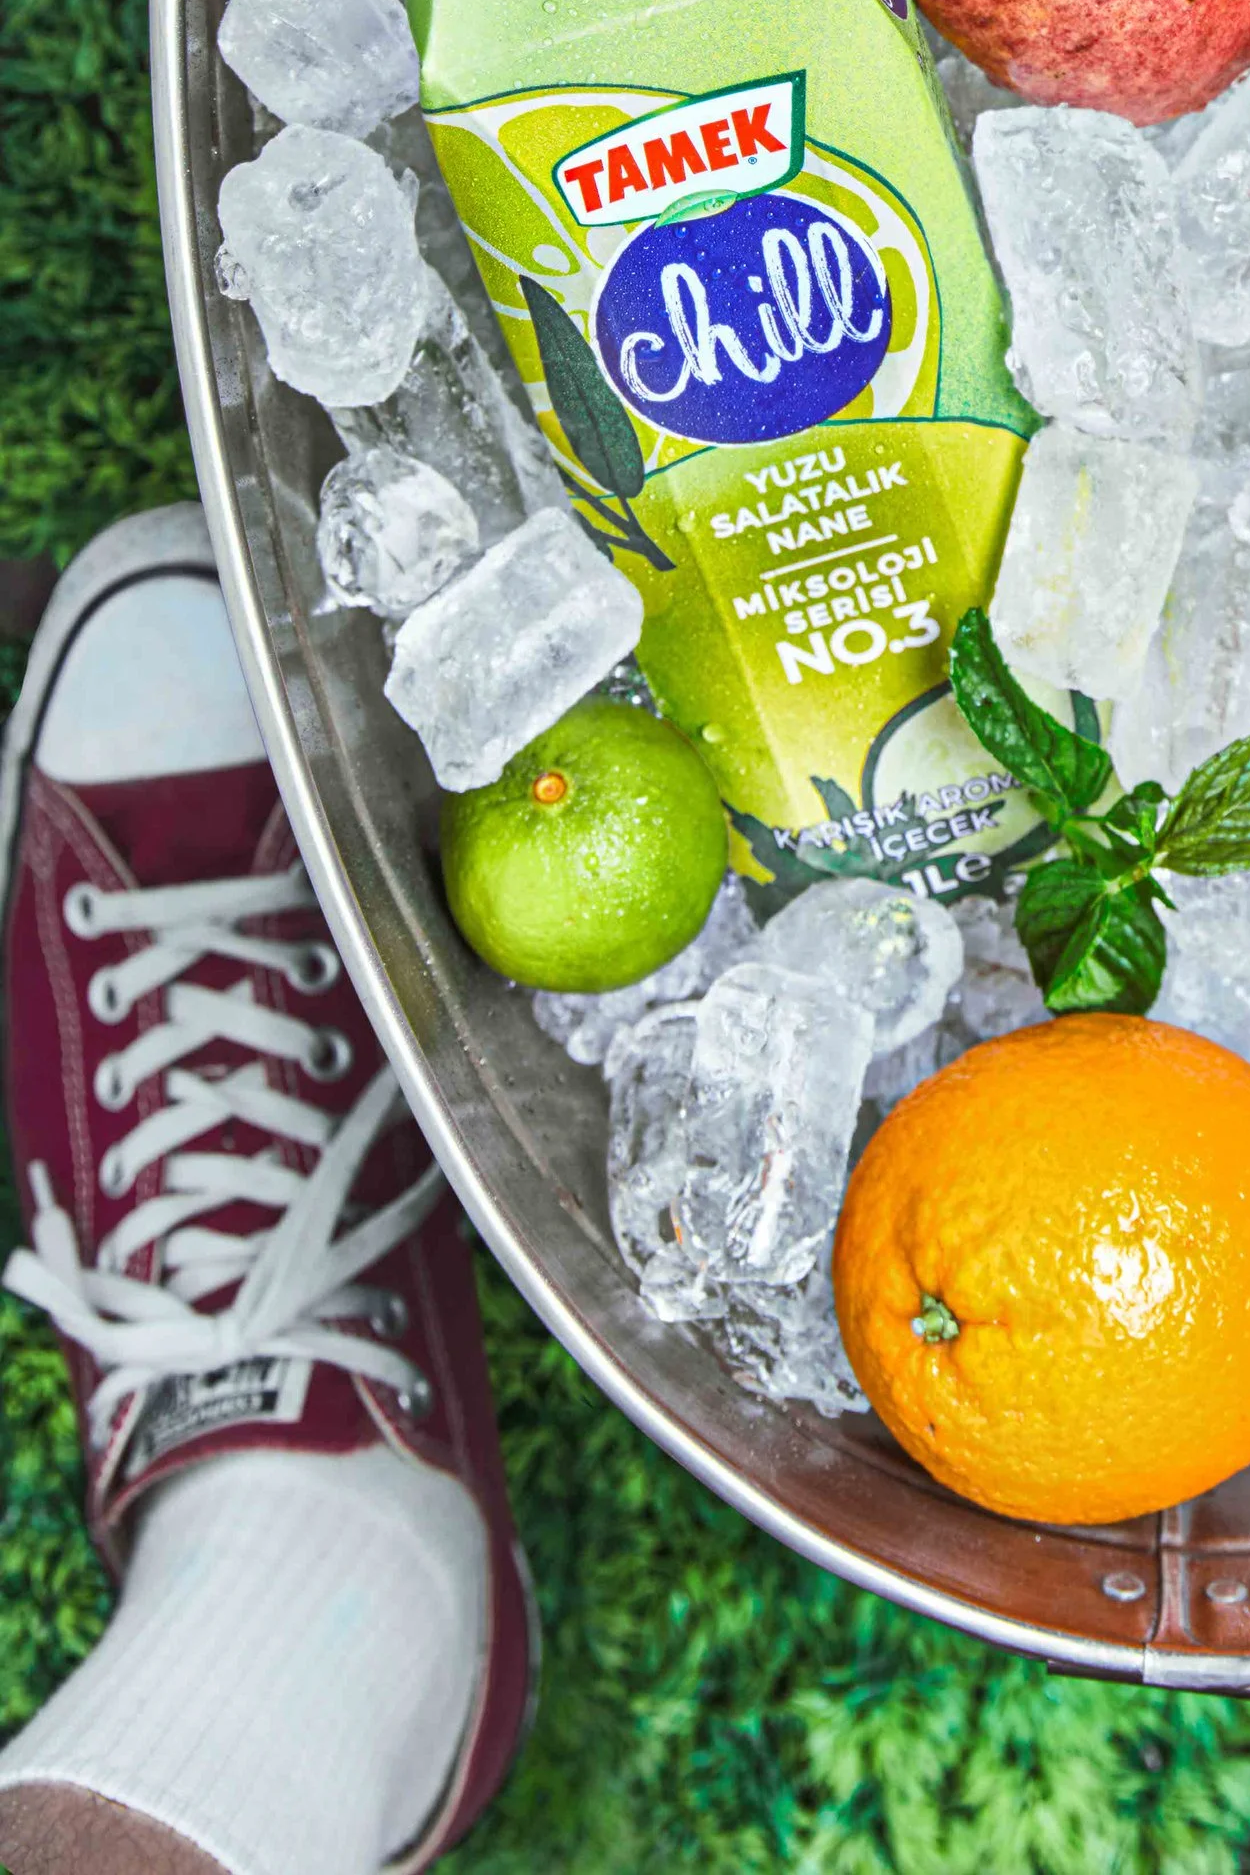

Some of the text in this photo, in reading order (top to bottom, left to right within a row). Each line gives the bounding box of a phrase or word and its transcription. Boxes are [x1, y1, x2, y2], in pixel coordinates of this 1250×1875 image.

[564, 103, 788, 213] TAMEK
[621, 222, 883, 401] chill
[709, 461, 908, 540] SALATALIK
[746, 447, 848, 496] YUZU
[767, 509, 873, 556] NANE
[733, 537, 939, 621] MİKSOLOJİ
[783, 575, 908, 635] SERİSİ
[776, 600, 941, 686] NO.3
[773, 771, 1022, 849] KARIŞIK AROM
[871, 807, 999, 862] İÇECEK
